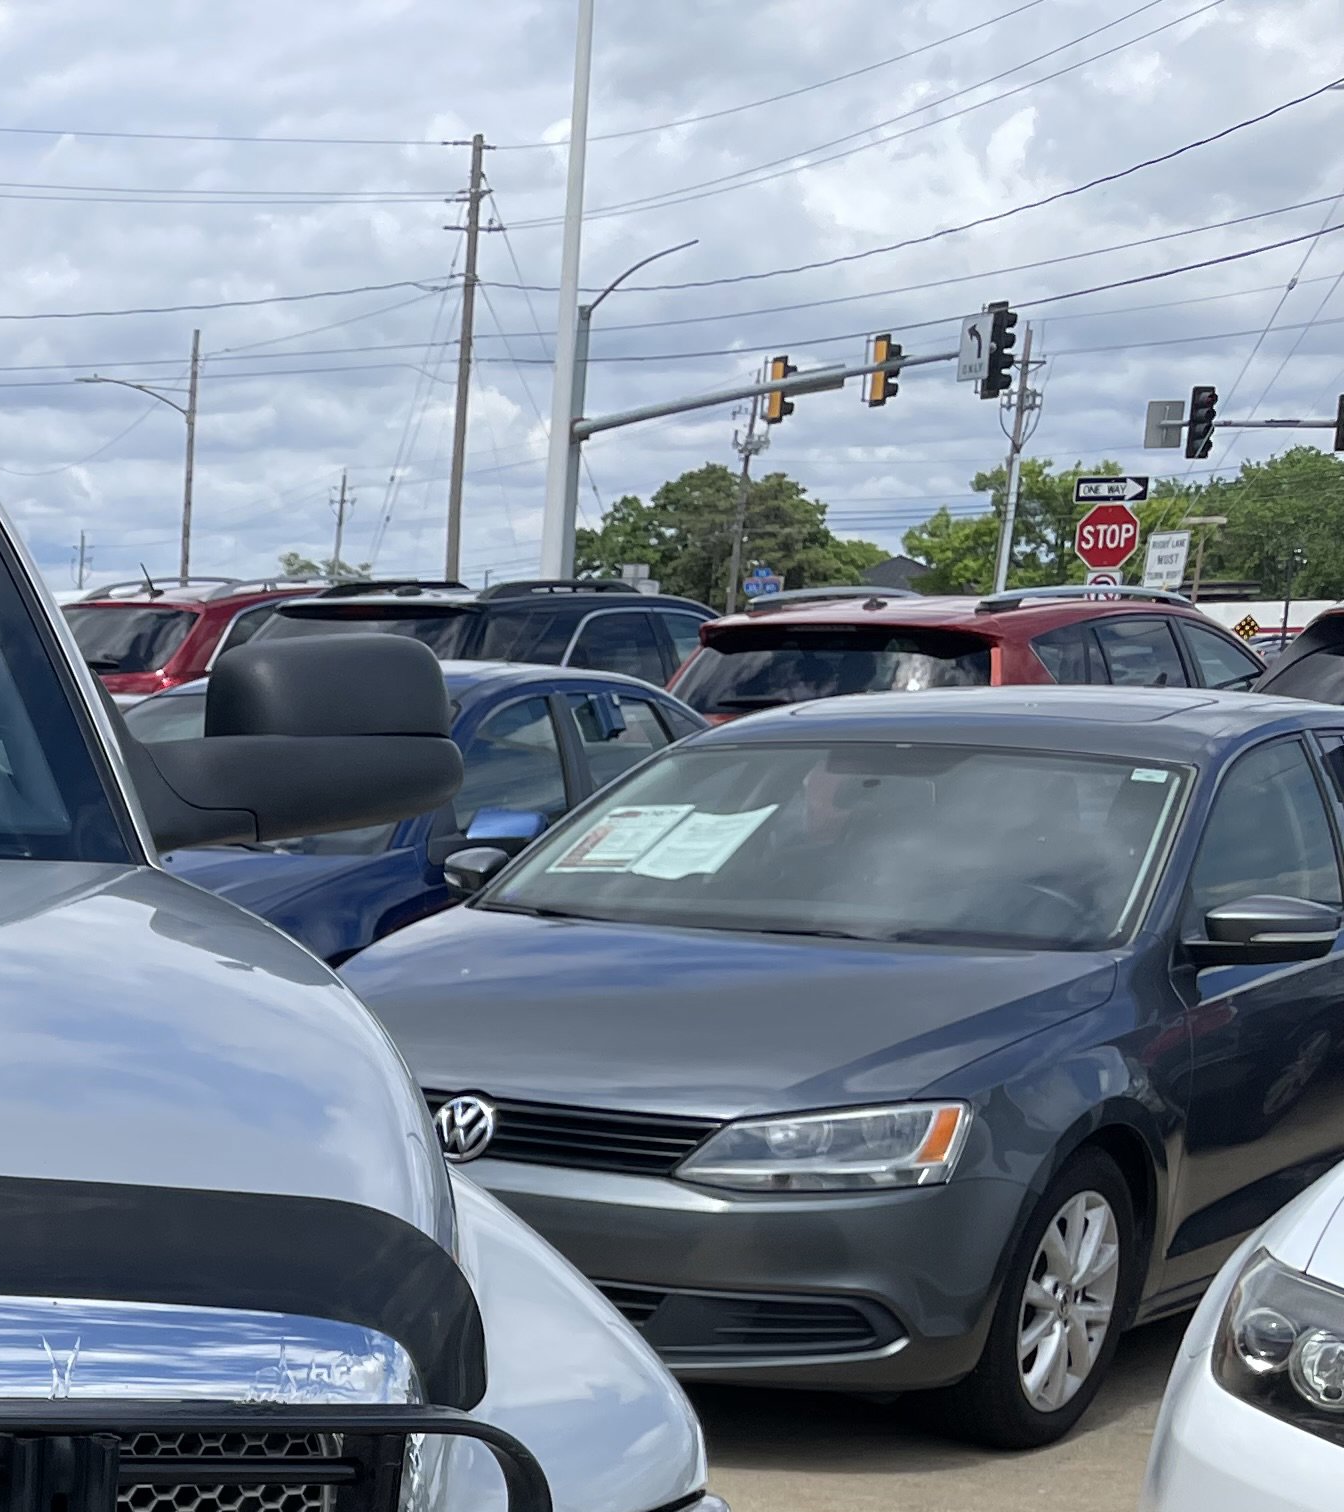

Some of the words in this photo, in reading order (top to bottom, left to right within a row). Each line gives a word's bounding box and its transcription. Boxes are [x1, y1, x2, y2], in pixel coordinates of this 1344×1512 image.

[1083, 484, 1101, 495] ONE
[1107, 483, 1127, 495] WAY
[1080, 523, 1135, 550] STOP
